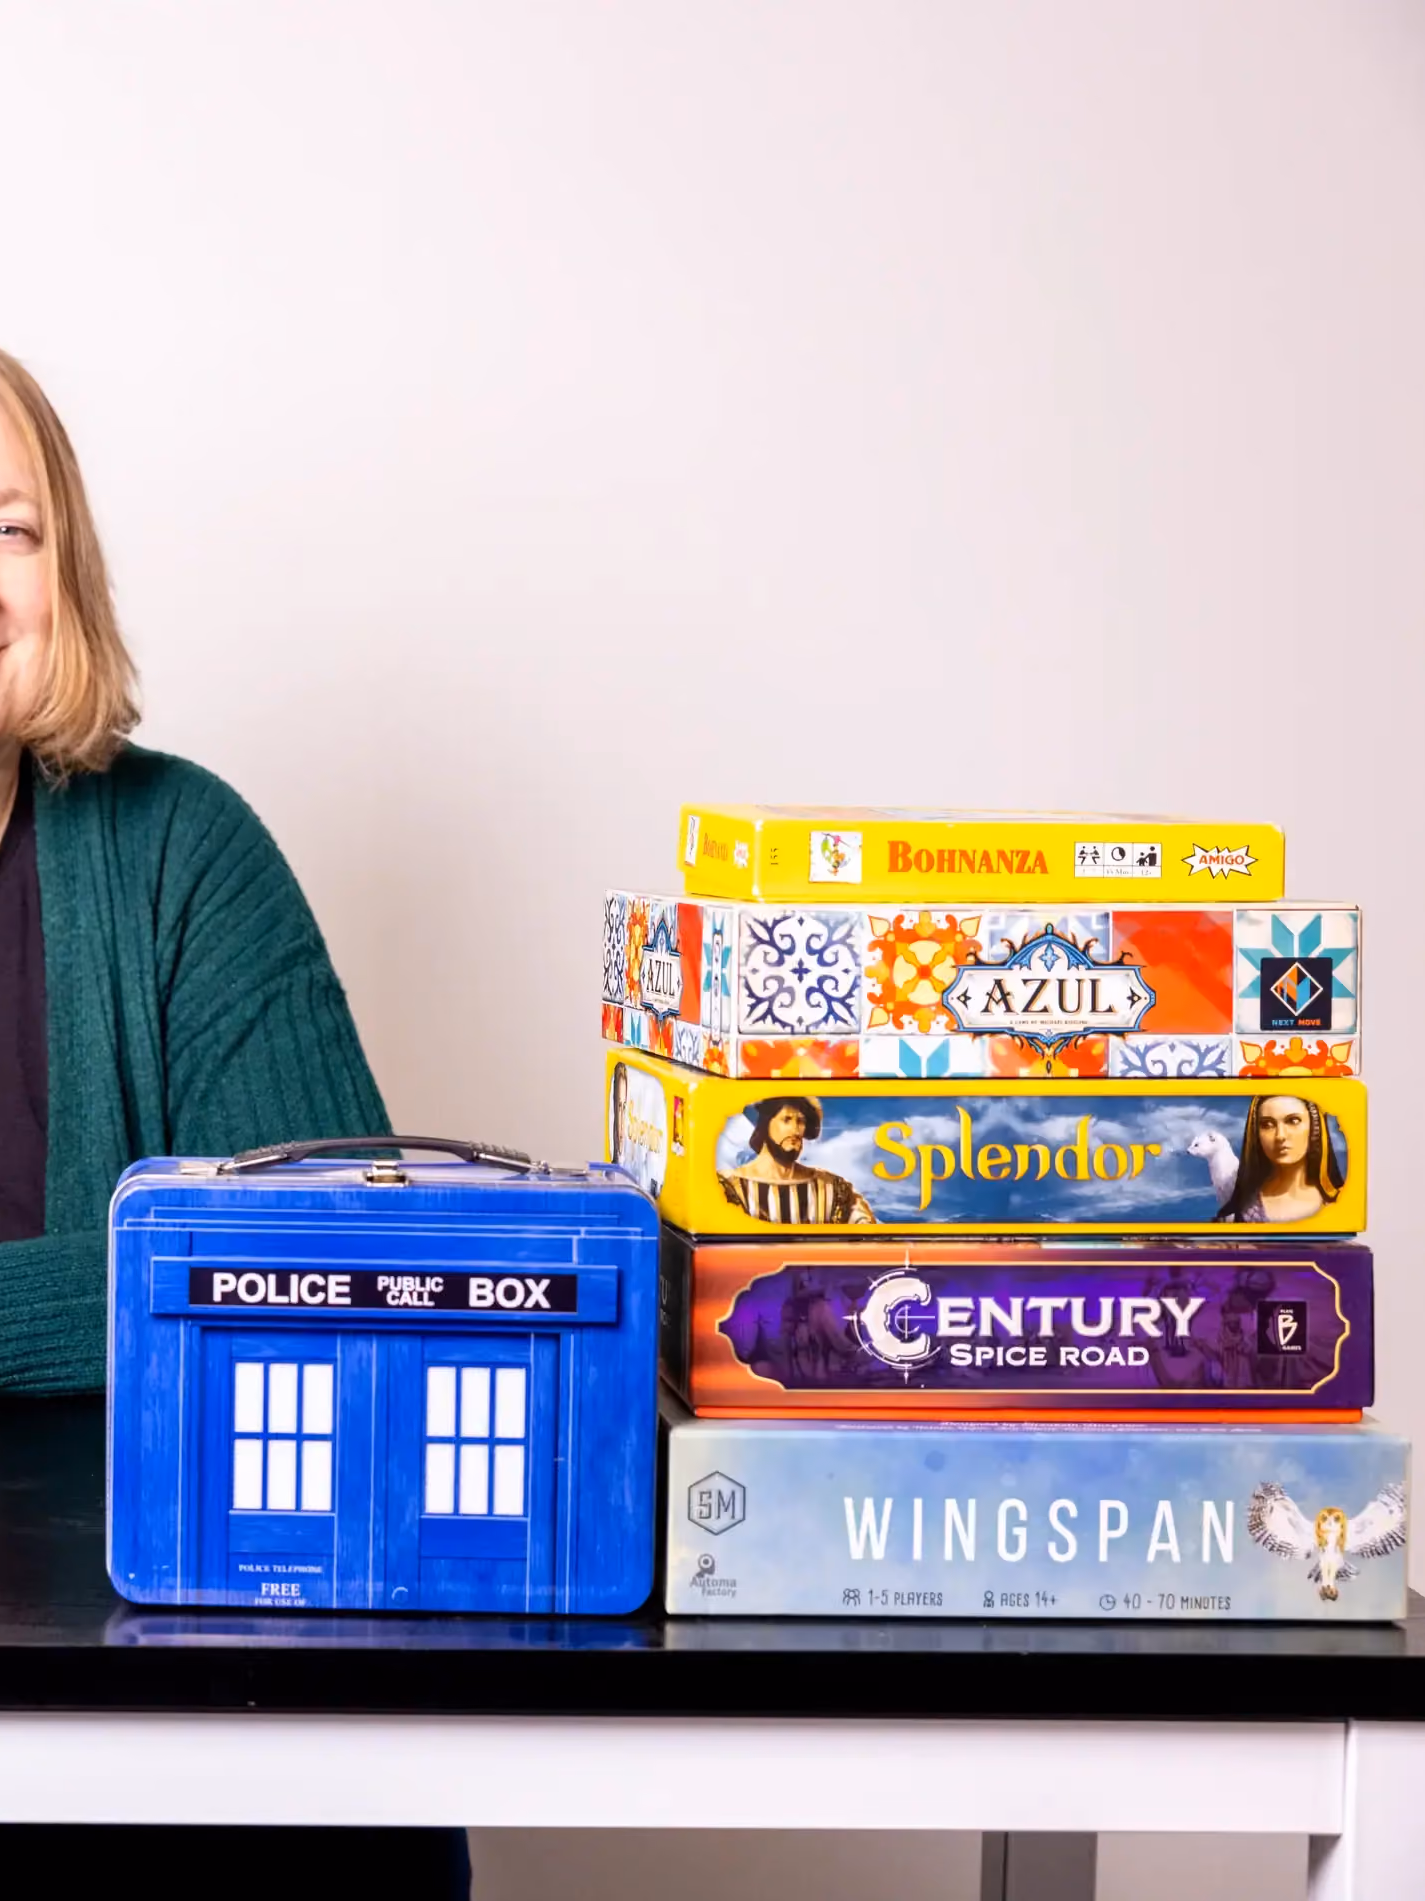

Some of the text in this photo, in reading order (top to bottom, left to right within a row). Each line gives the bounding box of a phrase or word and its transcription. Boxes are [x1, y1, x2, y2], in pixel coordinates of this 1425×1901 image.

[887, 840, 1049, 875] BOHNANZA
[1198, 854, 1245, 866] AMIGO
[646, 958, 675, 996] AZUL
[980, 978, 1116, 1014] AZUL
[1297, 1018, 1322, 1026] MOVE
[871, 1104, 1163, 1212] Splendor
[212, 1272, 551, 1309] POLICE PUBLIC BOX
[386, 1291, 435, 1307] CALL
[859, 1276, 1207, 1362] CENTURY
[950, 1342, 1150, 1367] SPICE ROAD
[699, 1489, 736, 1520] SM
[843, 1496, 1235, 1563] WINGSPAN
[238, 1564, 270, 1573] POLICE
[261, 1582, 301, 1597] FREE
[689, 1576, 737, 1588] Automa
[701, 1587, 737, 1598] Factory
[867, 1589, 944, 1607] 1-5 PLAYERS
[1000, 1590, 1058, 1608] AGES 14+
[1122, 1593, 1142, 1610] 40
[1157, 1593, 1176, 1610] 70
[1180, 1595, 1232, 1611] MINUTES
